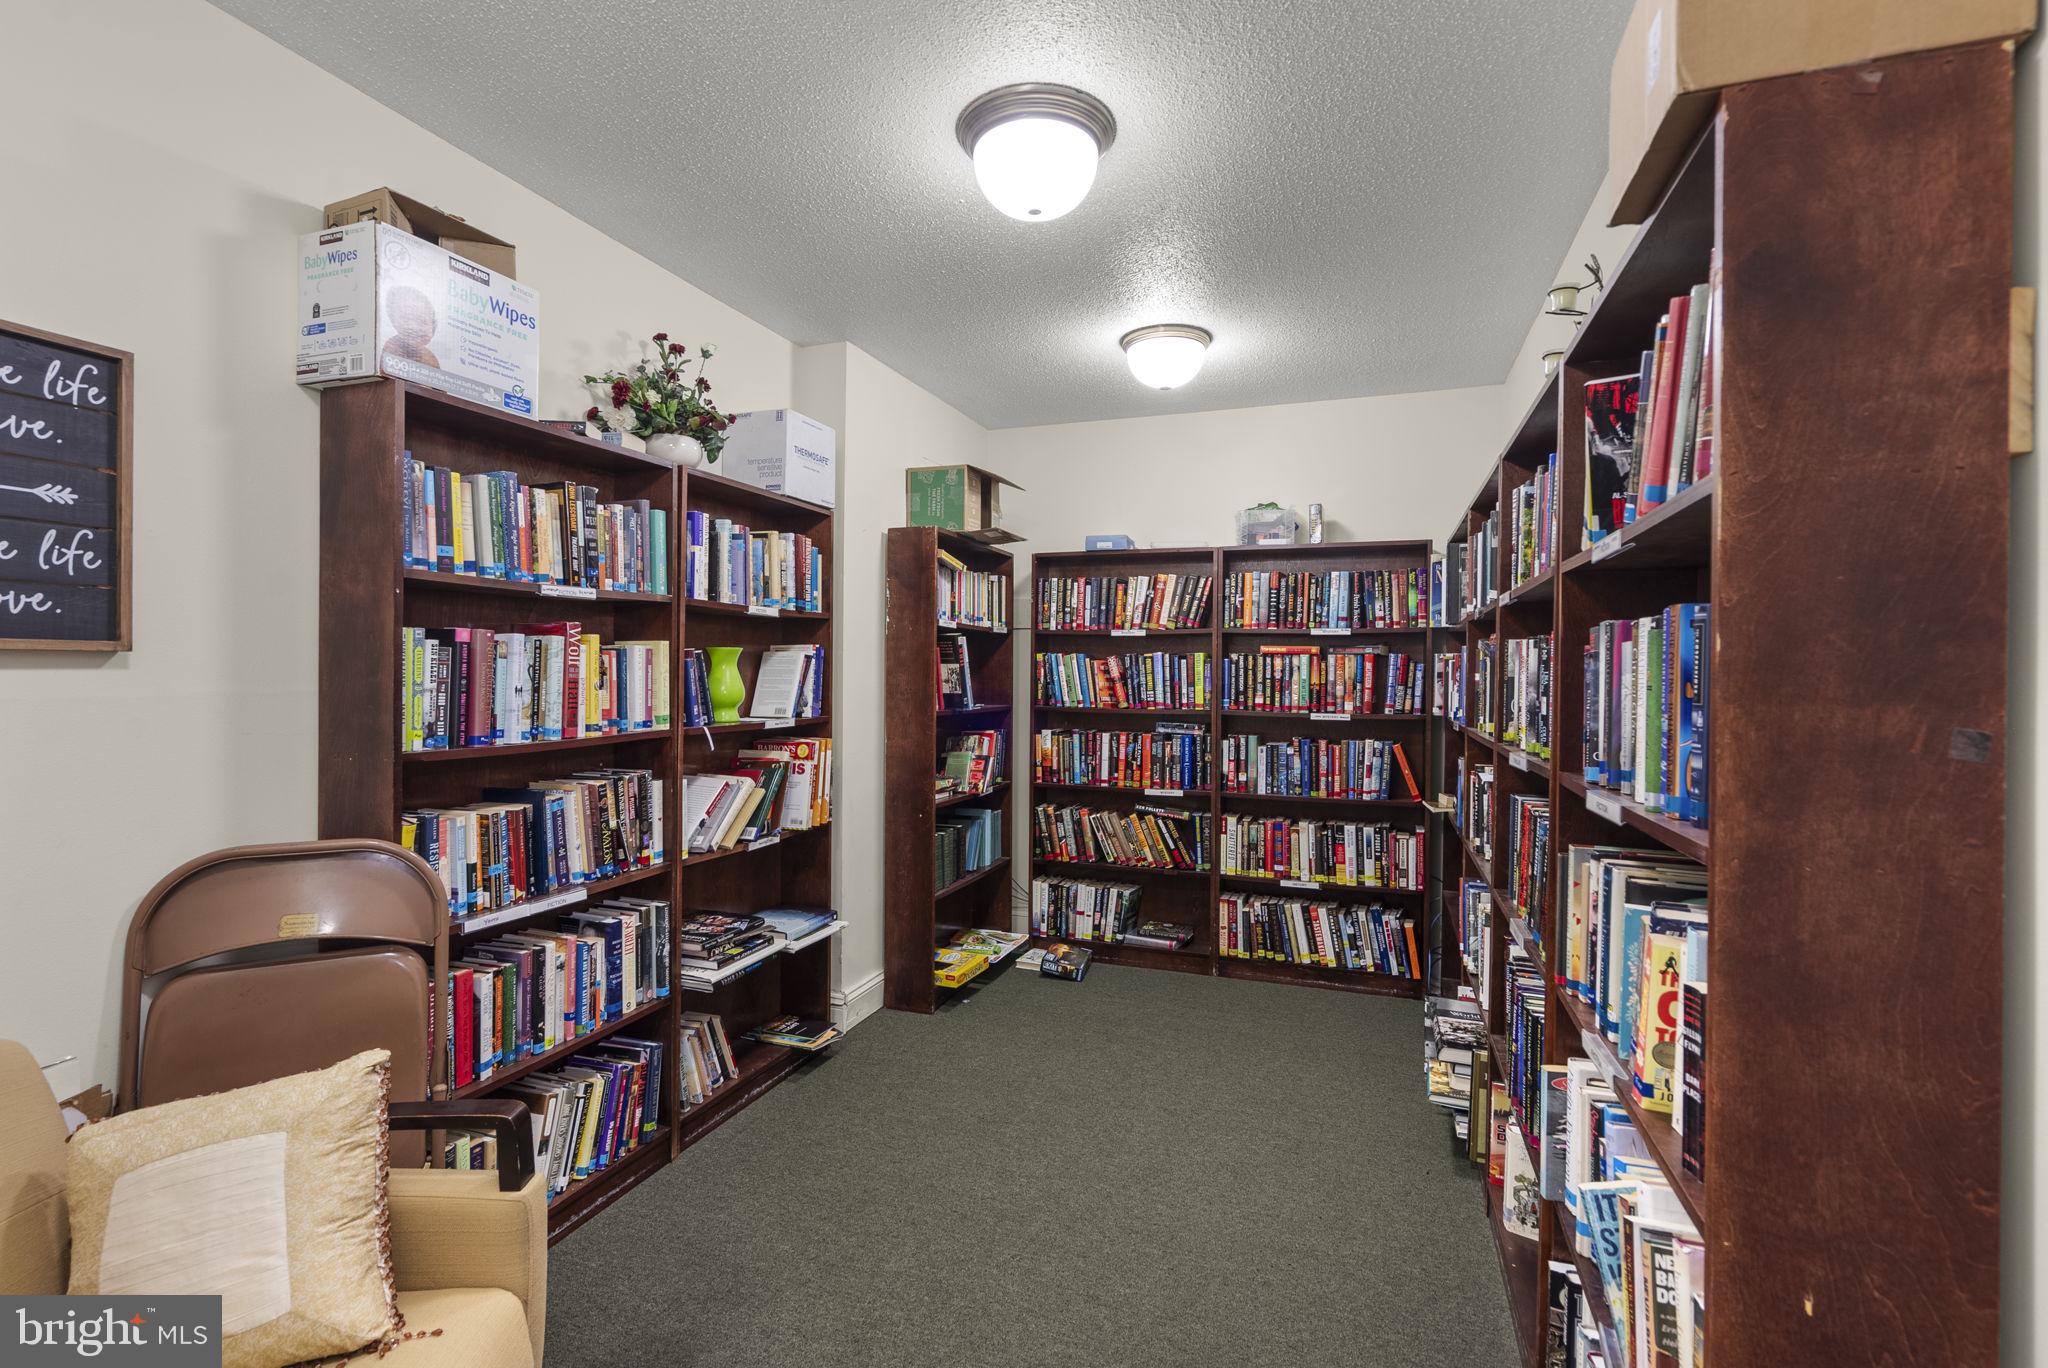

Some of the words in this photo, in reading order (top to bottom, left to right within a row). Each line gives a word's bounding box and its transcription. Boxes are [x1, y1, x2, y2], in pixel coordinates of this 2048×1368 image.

[450, 258, 490, 282] KIRKLAND
[506, 328, 528, 341] FREE
[385, 355, 409, 372] 900
[43, 360, 107, 410] life
[747, 457, 783, 467] temperature
[756, 463, 783, 472] sensitive
[793, 445, 830, 467] THERMOSAFE
[758, 470, 783, 479] product
[568, 485, 576, 499] JOHN
[39, 529, 102, 576] life
[568, 621, 582, 665] Wolf
[1668, 614, 1677, 650] JACKIE
[430, 657, 438, 684] KILLER
[567, 680, 578, 710] Hall
[757, 744, 796, 753] BARRON'S
[1228, 828, 1236, 861] SHATTERED
[547, 897, 567, 908] FICTION
[1594, 1193, 1618, 1223] IT
